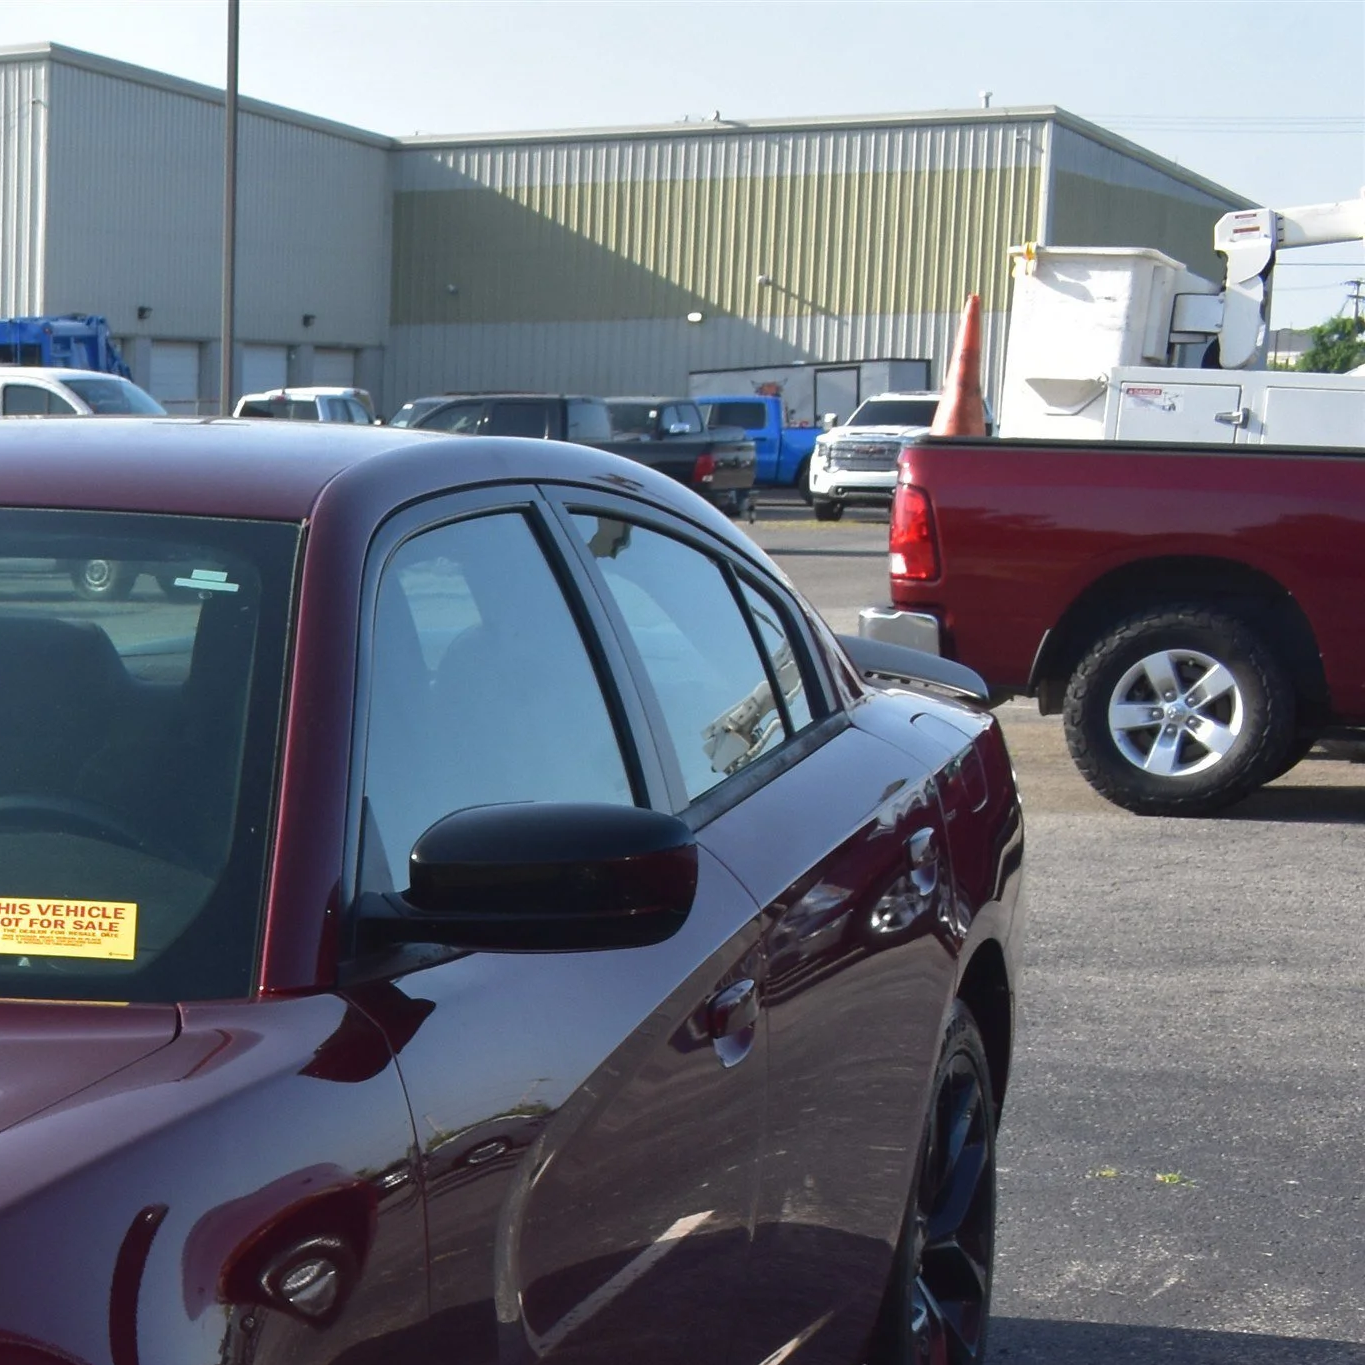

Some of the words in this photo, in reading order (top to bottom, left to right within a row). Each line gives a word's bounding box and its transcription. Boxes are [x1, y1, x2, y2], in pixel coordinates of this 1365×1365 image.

[37, 904, 126, 920] VEHICLE
[29, 918, 66, 929] FOR
[72, 920, 120, 932] SALE
